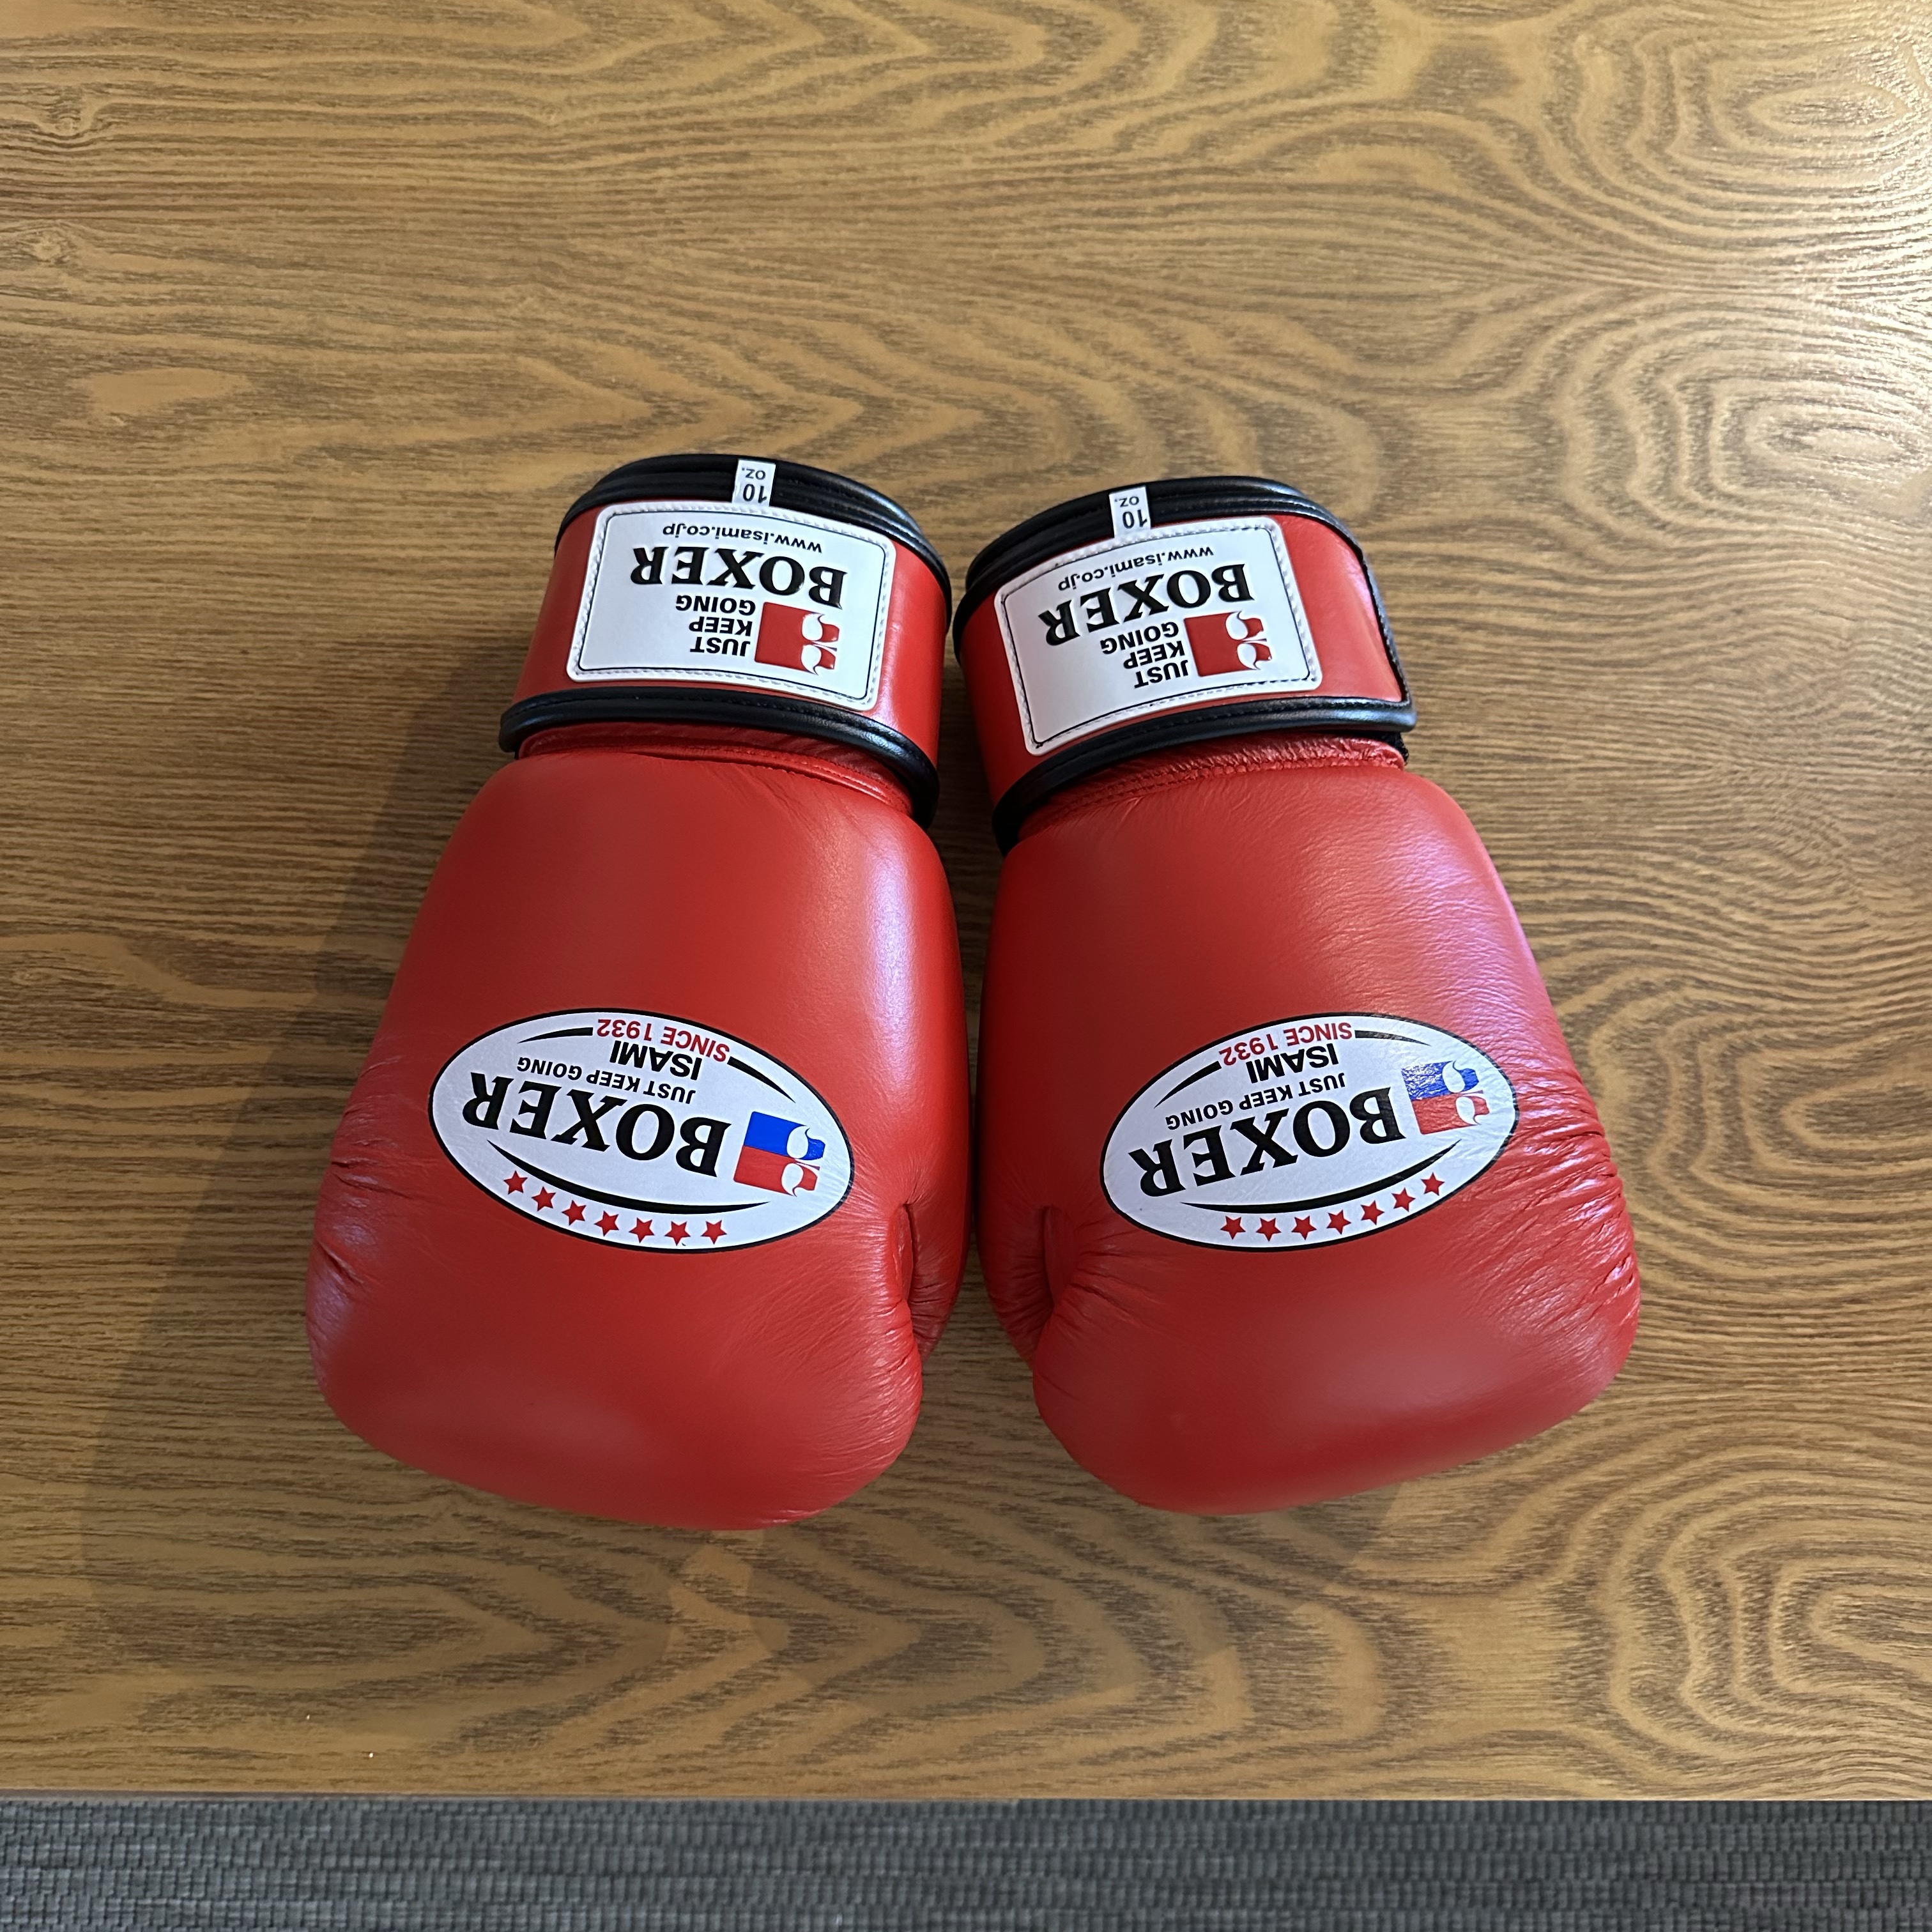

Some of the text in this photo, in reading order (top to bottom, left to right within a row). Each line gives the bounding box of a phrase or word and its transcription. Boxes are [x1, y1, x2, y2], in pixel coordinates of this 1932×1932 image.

[741, 468, 766, 480] oz.
[742, 484, 767, 503] 10
[1114, 496, 1139, 507] oz.
[1123, 510, 1147, 529] 10
[663, 523, 822, 553] www.isami.co.jp
[631, 546, 848, 610] BOXER
[1059, 546, 1213, 590] www.isami.co.jp
[676, 595, 756, 615] GOING
[1038, 564, 1254, 646] BOXER
[689, 616, 753, 636] KEEP
[1101, 622, 1179, 654] GOING
[690, 636, 750, 657] JUST
[1123, 641, 1185, 668] KEEP
[1134, 660, 1188, 688] JUST
[597, 1019, 729, 1062] SINCE 1932
[1219, 1022, 1353, 1065] SINCE 1932
[610, 1040, 702, 1081] ISAMI
[1247, 1043, 1338, 1084] ISAMI
[517, 1057, 696, 1105] JUST KEEP GOING
[1165, 1073, 1346, 1130] JUST KEEP GOING
[462, 1072, 732, 1177] BOXER
[1128, 1087, 1406, 1197] BOXER
